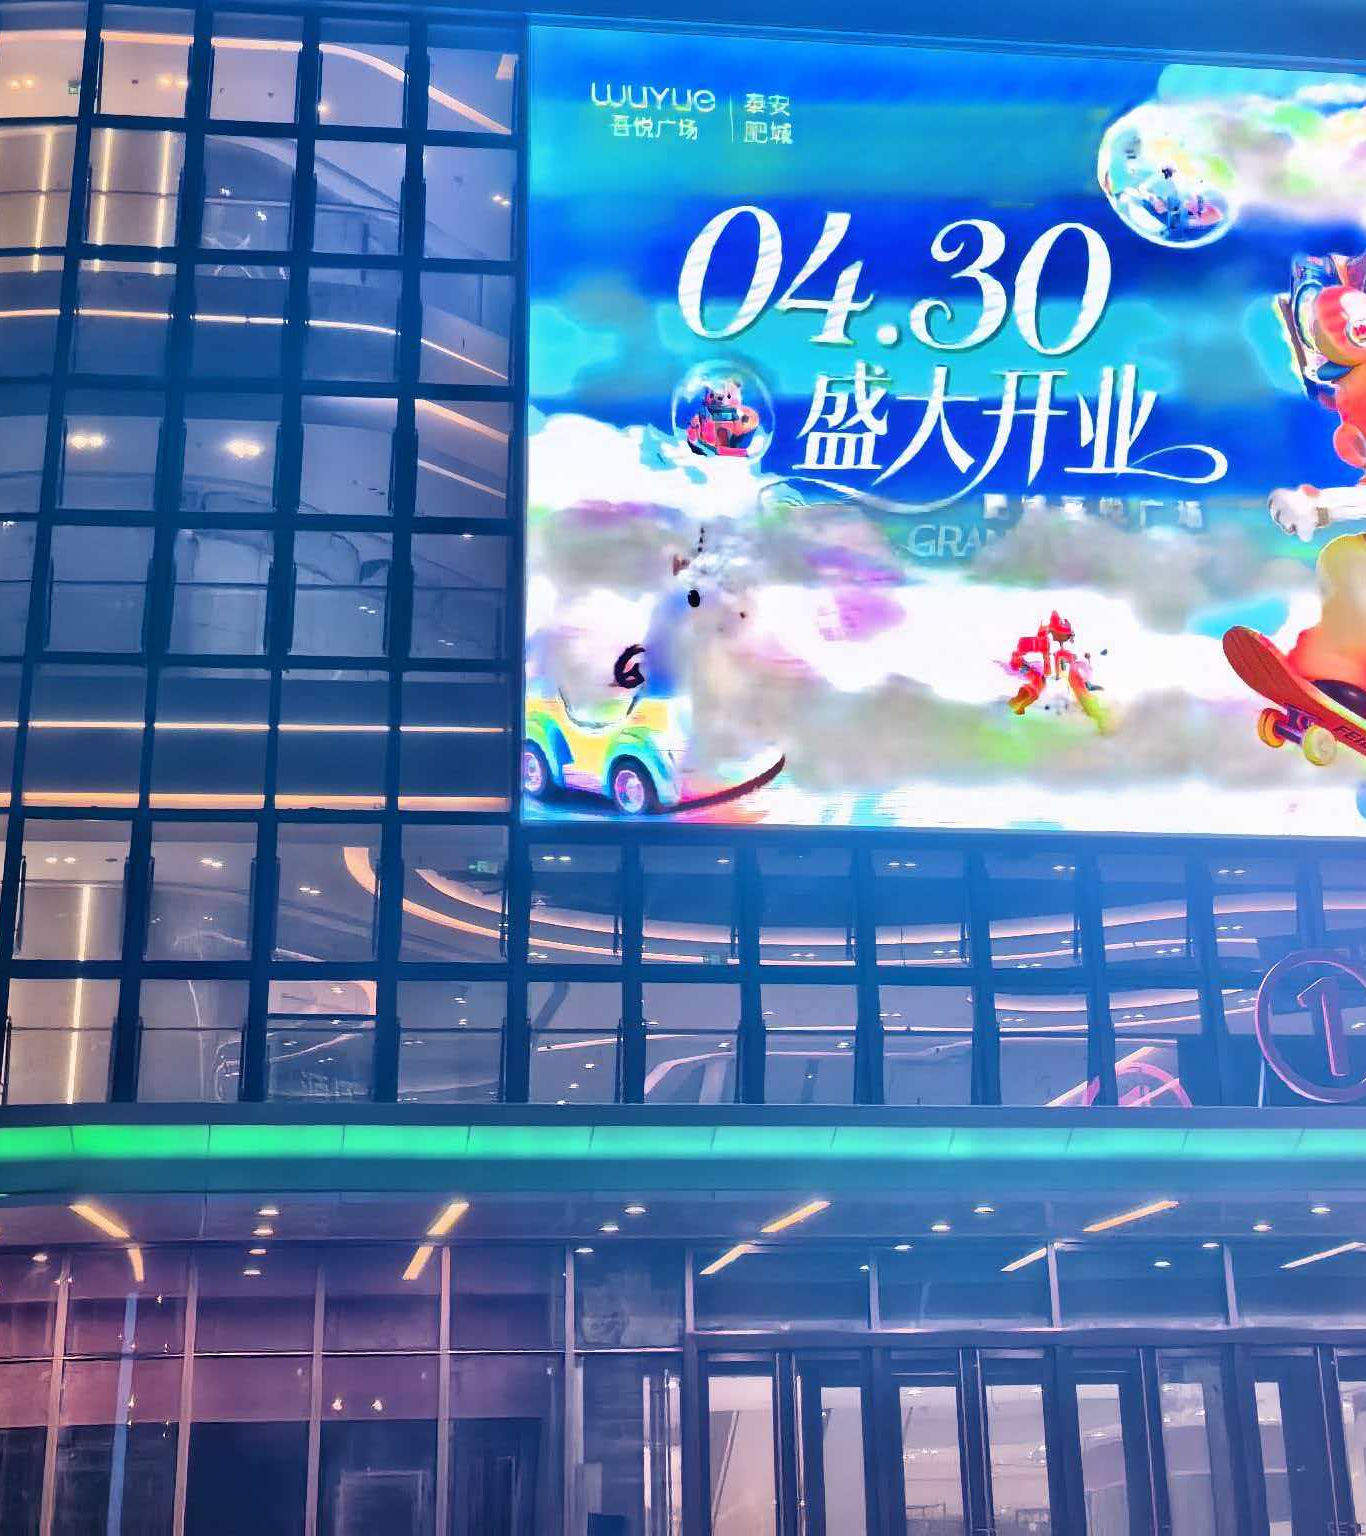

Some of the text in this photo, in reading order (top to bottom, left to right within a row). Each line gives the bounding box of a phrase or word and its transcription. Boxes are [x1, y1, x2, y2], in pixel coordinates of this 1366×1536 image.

[612, 114, 698, 141] 吾悦广场
[677, 205, 1111, 356] 04.30
[791, 361, 1227, 490] 盛大开业
